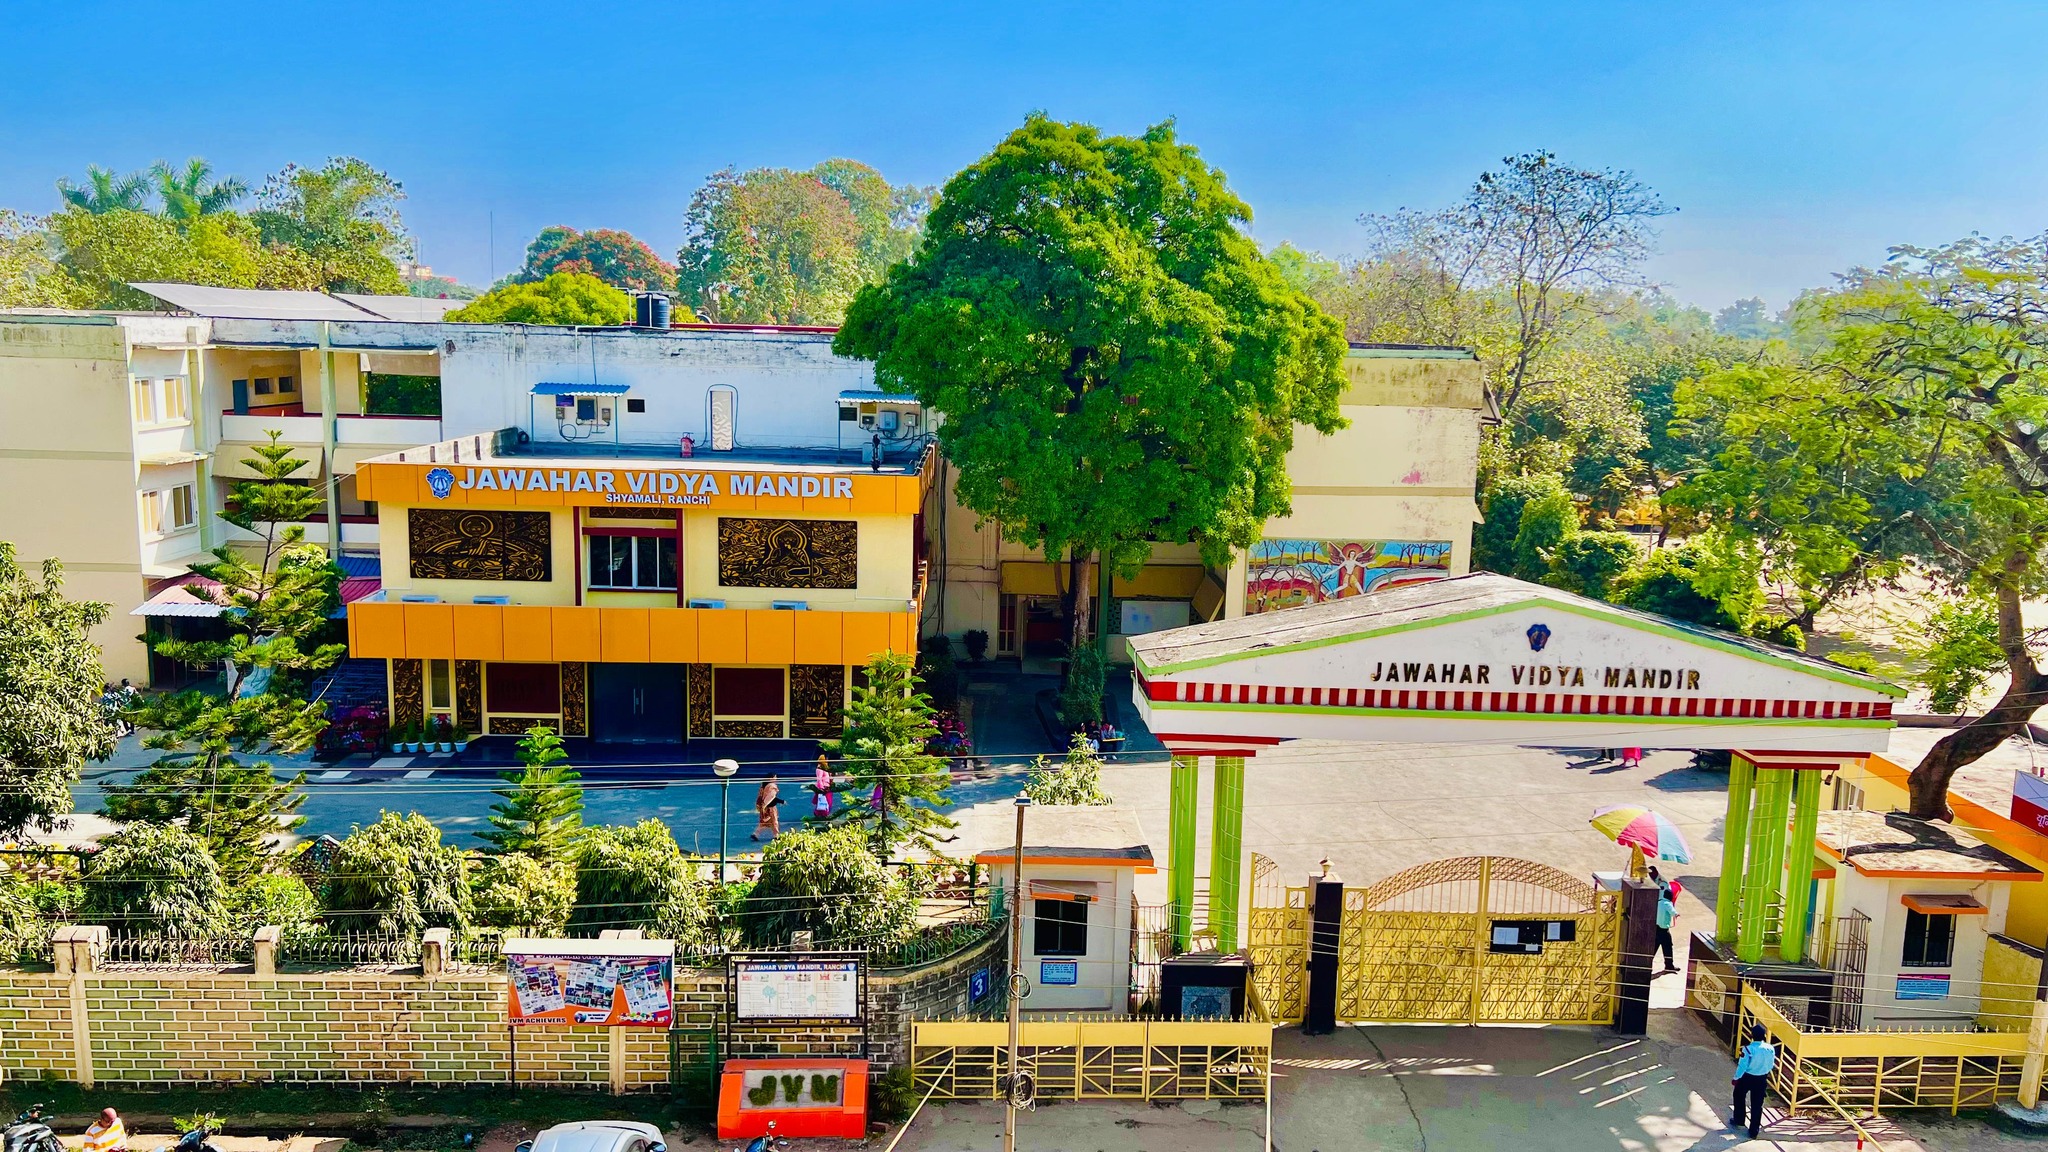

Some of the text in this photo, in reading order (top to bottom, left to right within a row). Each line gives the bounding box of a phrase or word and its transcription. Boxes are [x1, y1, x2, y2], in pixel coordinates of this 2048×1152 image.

[458, 467, 853, 499] JAWAHAR VIDYA MANDIR
[606, 493, 711, 505] SHYAMALI, RANCHI
[1370, 662, 1700, 690] JAWAHAR VIDYA MANDIR
[974, 978, 983, 996] 3
